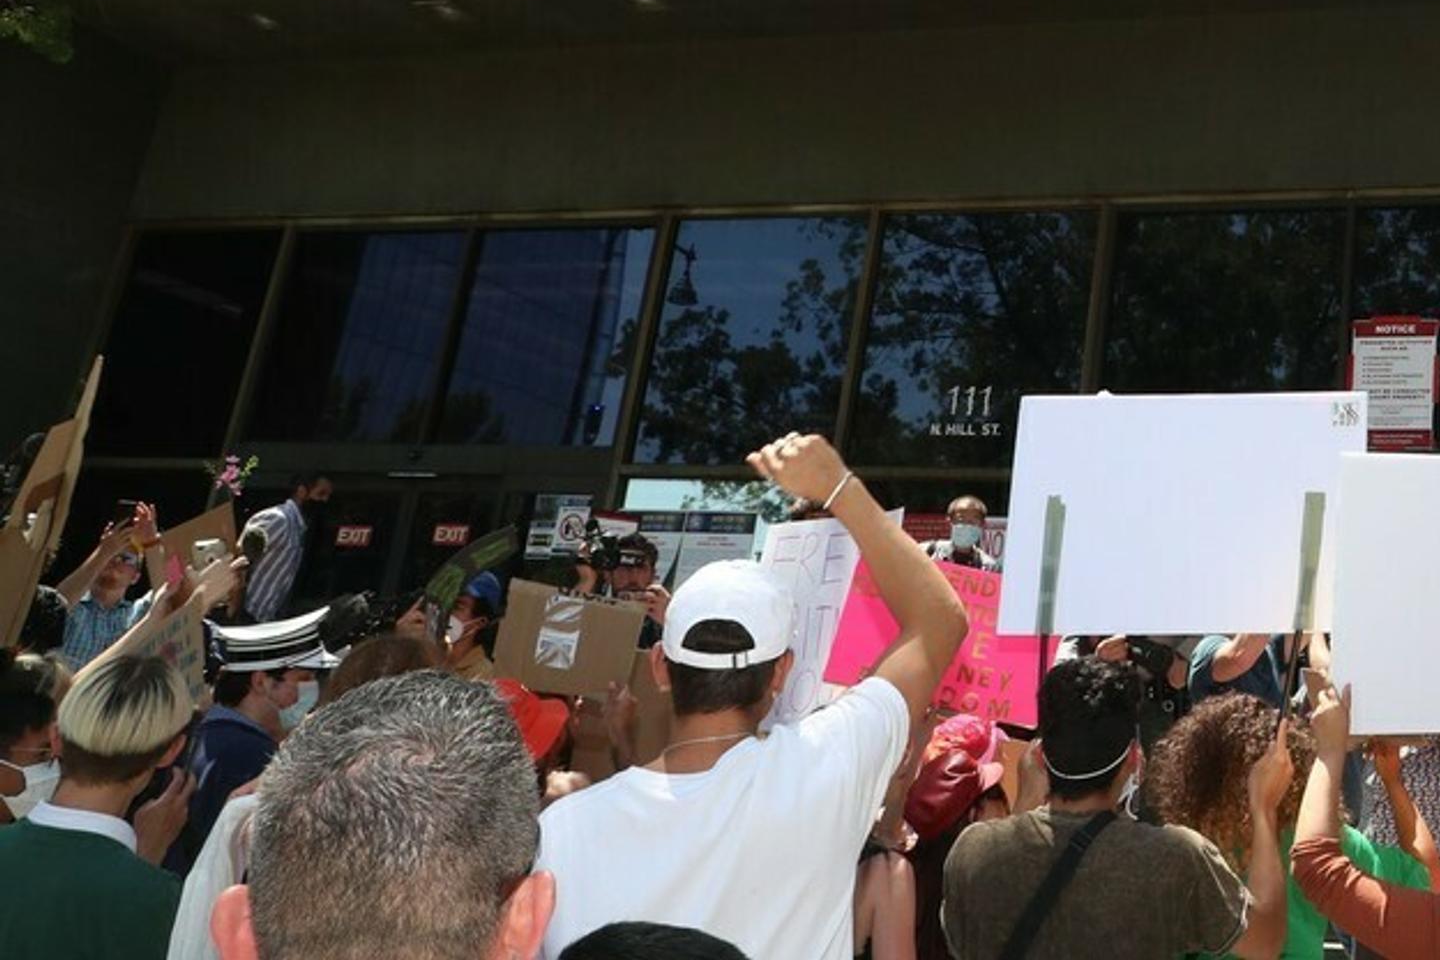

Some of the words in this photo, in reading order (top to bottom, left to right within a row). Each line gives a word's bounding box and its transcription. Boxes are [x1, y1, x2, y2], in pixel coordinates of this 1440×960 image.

[1375, 324, 1417, 335] NOTICE
[947, 385, 993, 417] 111
[945, 423, 977, 436] HILL
[336, 527, 371, 543] EXIT
[434, 525, 469, 542] EXIT
[771, 531, 850, 588] FRE
